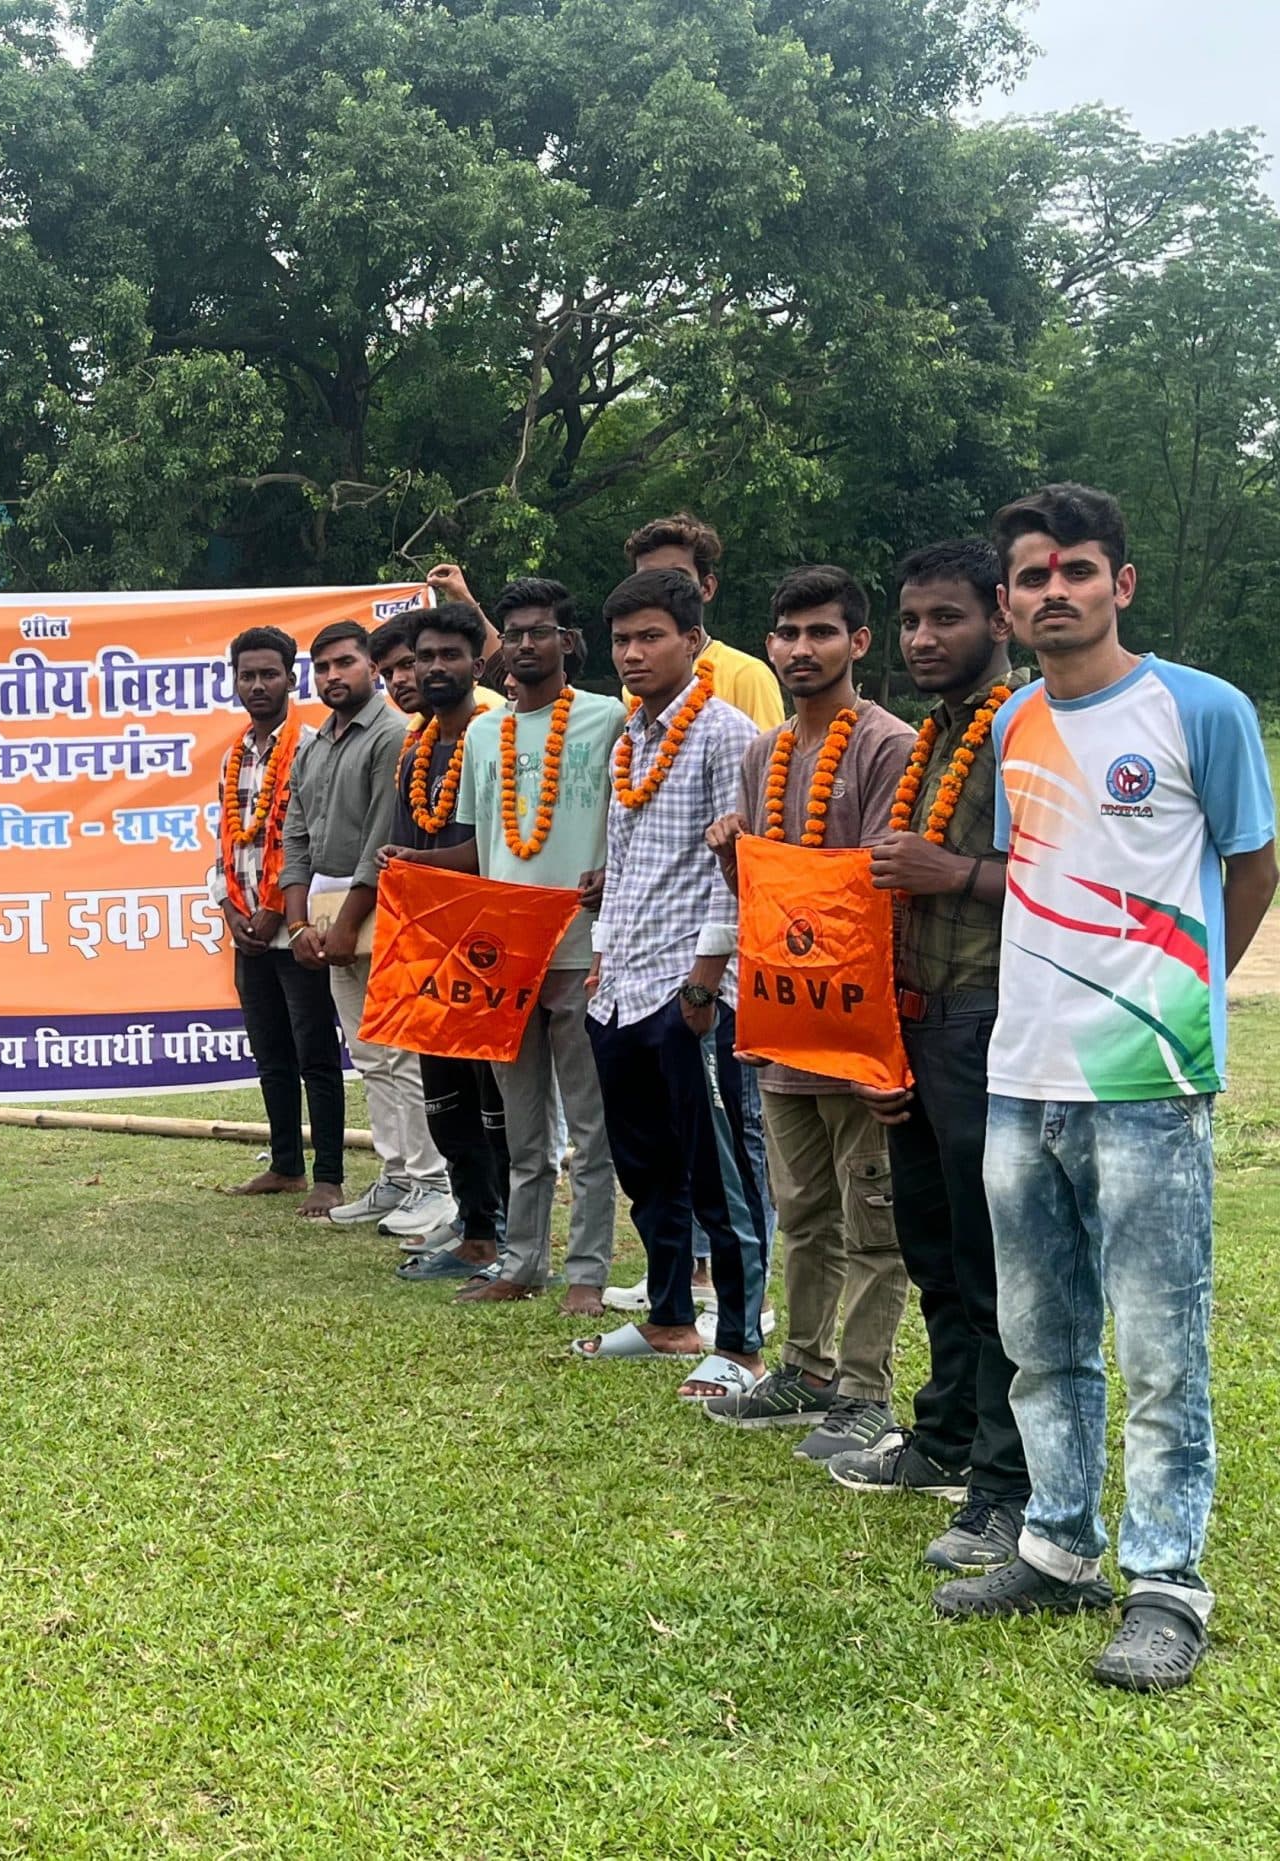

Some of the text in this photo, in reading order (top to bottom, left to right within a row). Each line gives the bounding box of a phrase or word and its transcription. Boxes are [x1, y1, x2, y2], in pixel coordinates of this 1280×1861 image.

[22, 617, 68, 638] शील
[115, 806, 197, 849] राष्ट्र
[1100, 803, 1154, 818] INDIA
[64, 865, 226, 960] इकाई
[752, 969, 866, 1014] ABVP
[34, 1023, 156, 1069] विद्यार्थी
